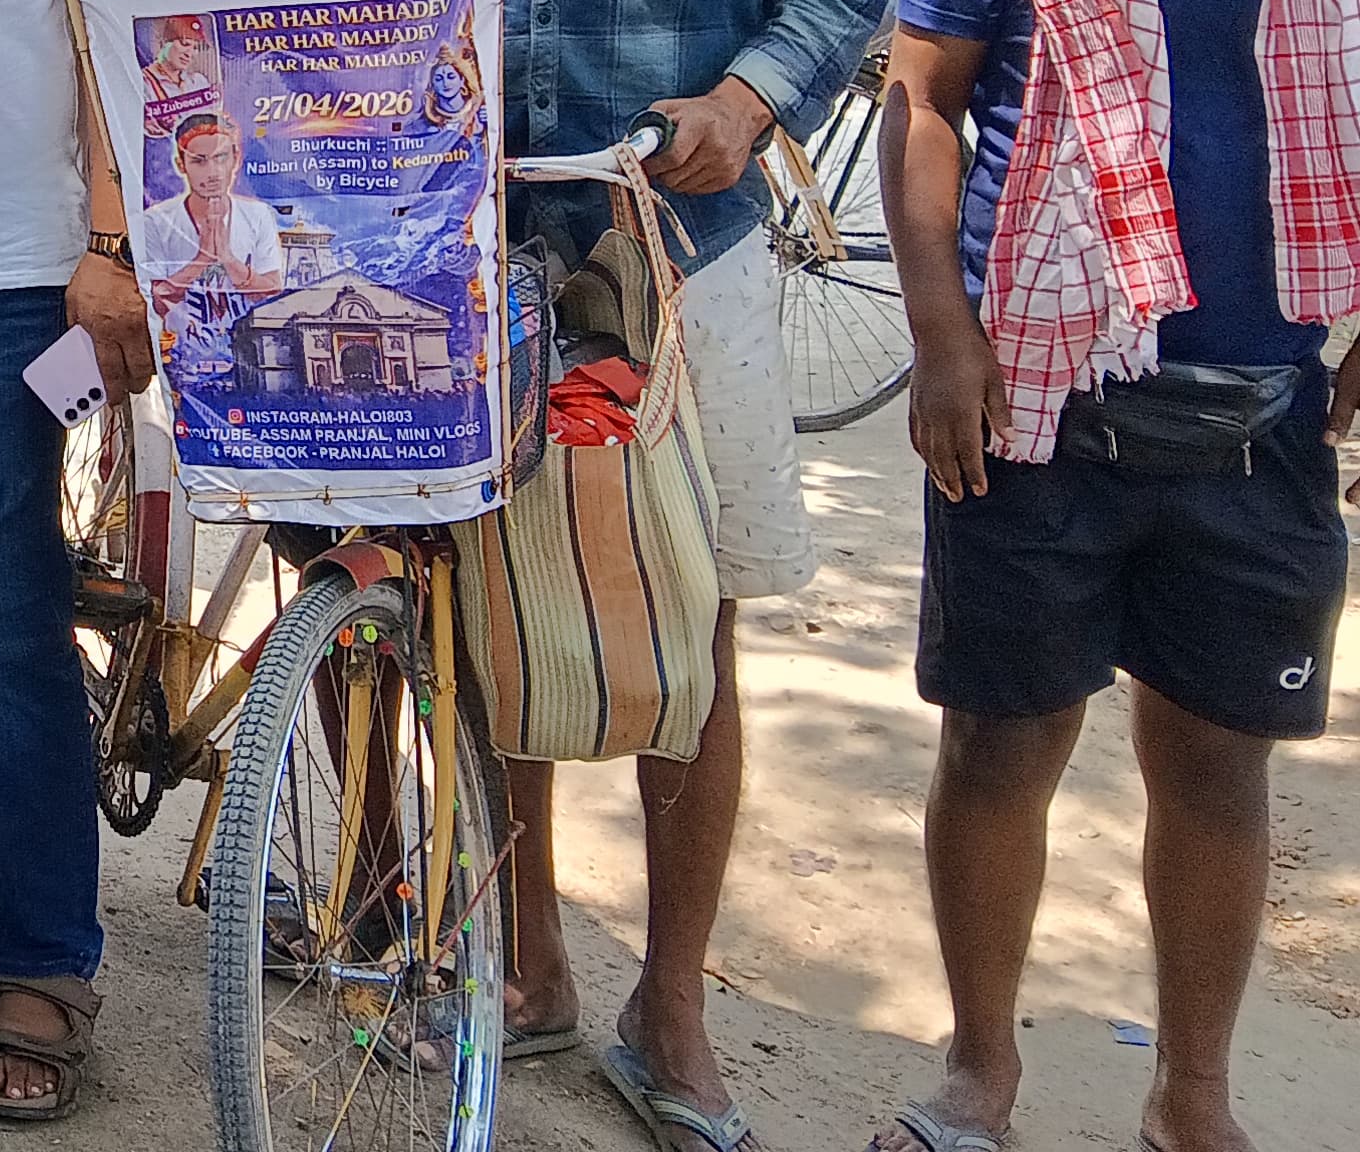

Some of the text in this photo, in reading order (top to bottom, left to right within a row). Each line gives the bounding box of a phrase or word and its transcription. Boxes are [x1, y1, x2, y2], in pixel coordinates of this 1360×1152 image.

[224, 12, 276, 32] HAR
[280, 9, 333, 28] HAR
[245, 23, 439, 52] HAR HAR MAHADEV
[261, 50, 428, 72] HAR HAR MAHADEV
[162, 96, 202, 113] Zubeen
[253, 90, 413, 122] 27/04/2026
[291, 137, 370, 152] Bhurkuchi
[391, 137, 424, 151] Tihu
[246, 148, 469, 175] Nalbari (Assam) to Kedarnath
[316, 174, 398, 190] by Bicycle
[246, 410, 413, 424] INSTAGRAM-HALOI803
[260, 429, 312, 441] ASSAM
[315, 428, 393, 442] PRANJAL,
[397, 428, 430, 441] MINI
[433, 421, 481, 440] VLOGS
[224, 445, 308, 458] FACEBOOK
[320, 447, 393, 459] PRANJAL
[397, 445, 446, 459] HALOI
